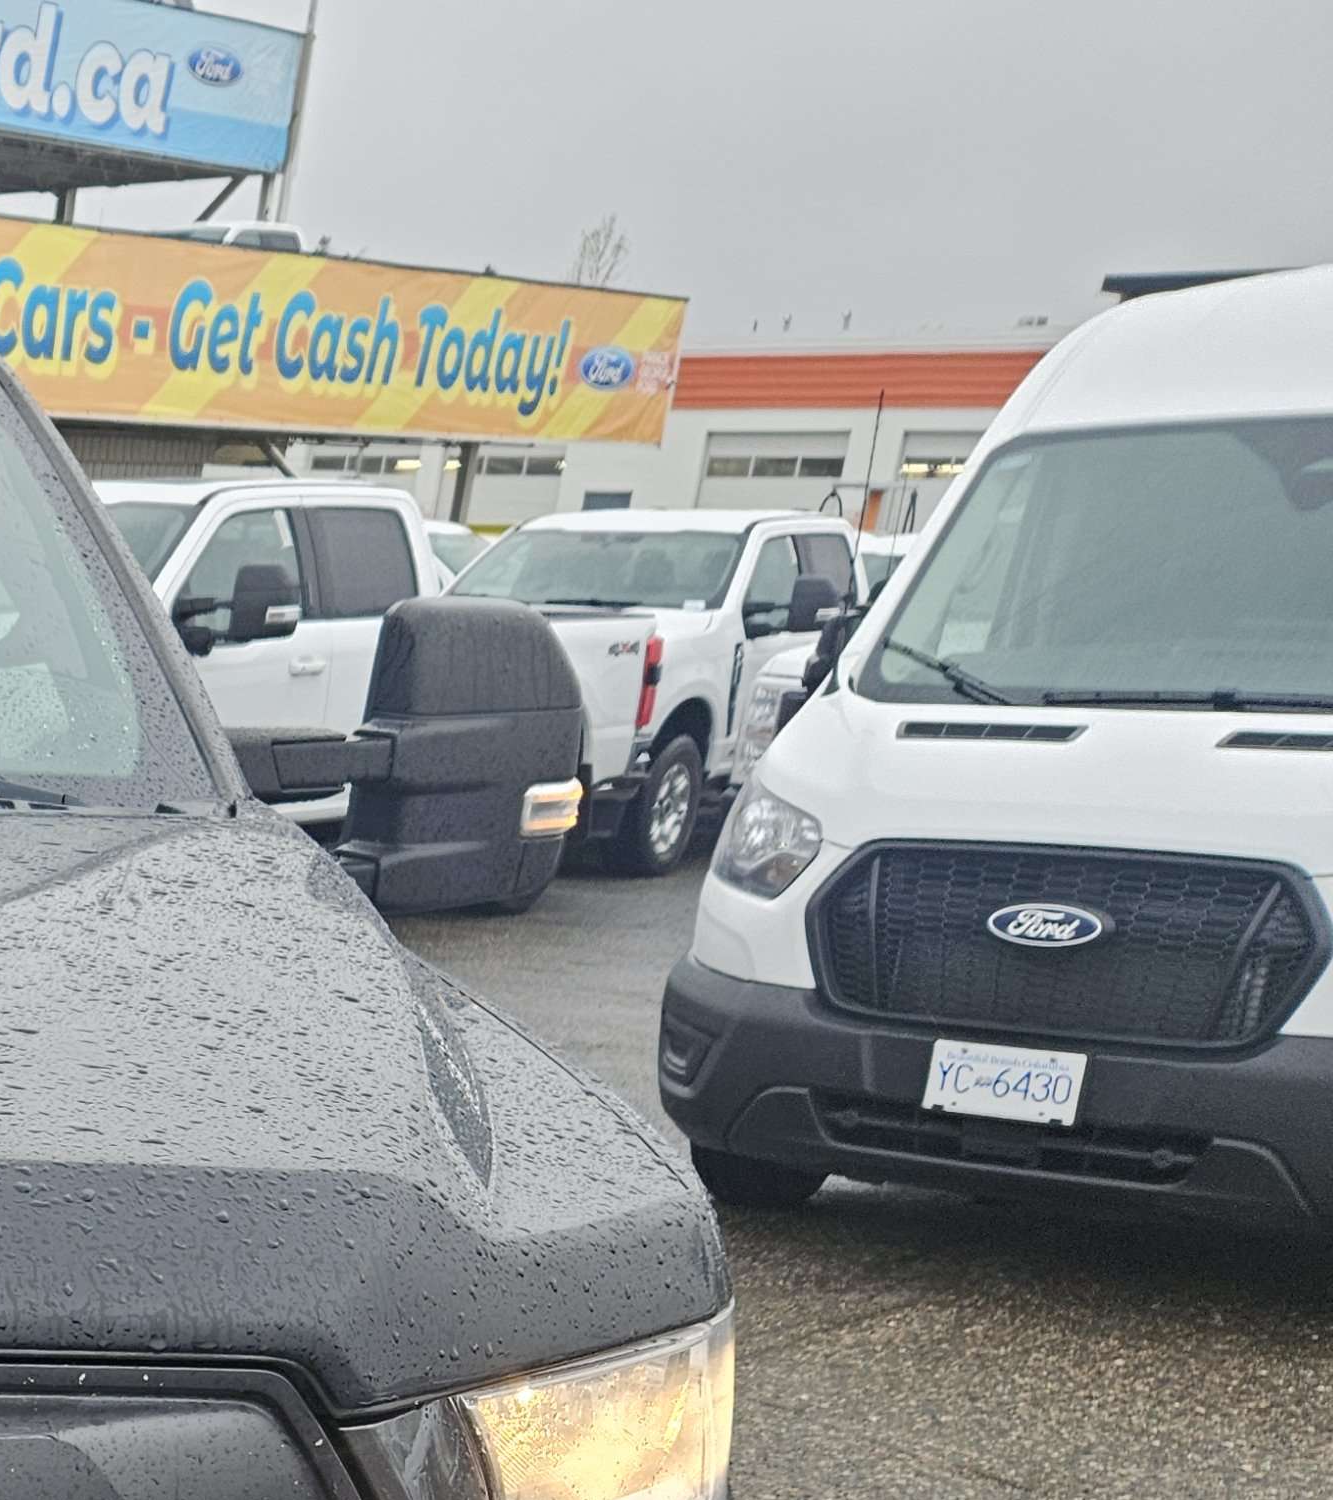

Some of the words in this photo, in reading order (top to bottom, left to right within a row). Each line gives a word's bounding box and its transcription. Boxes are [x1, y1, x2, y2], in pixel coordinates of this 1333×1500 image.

[170, 279, 263, 376] Get
[275, 290, 400, 385] Cash
[415, 304, 571, 416] Today!
[1007, 909, 1081, 940] Ford
